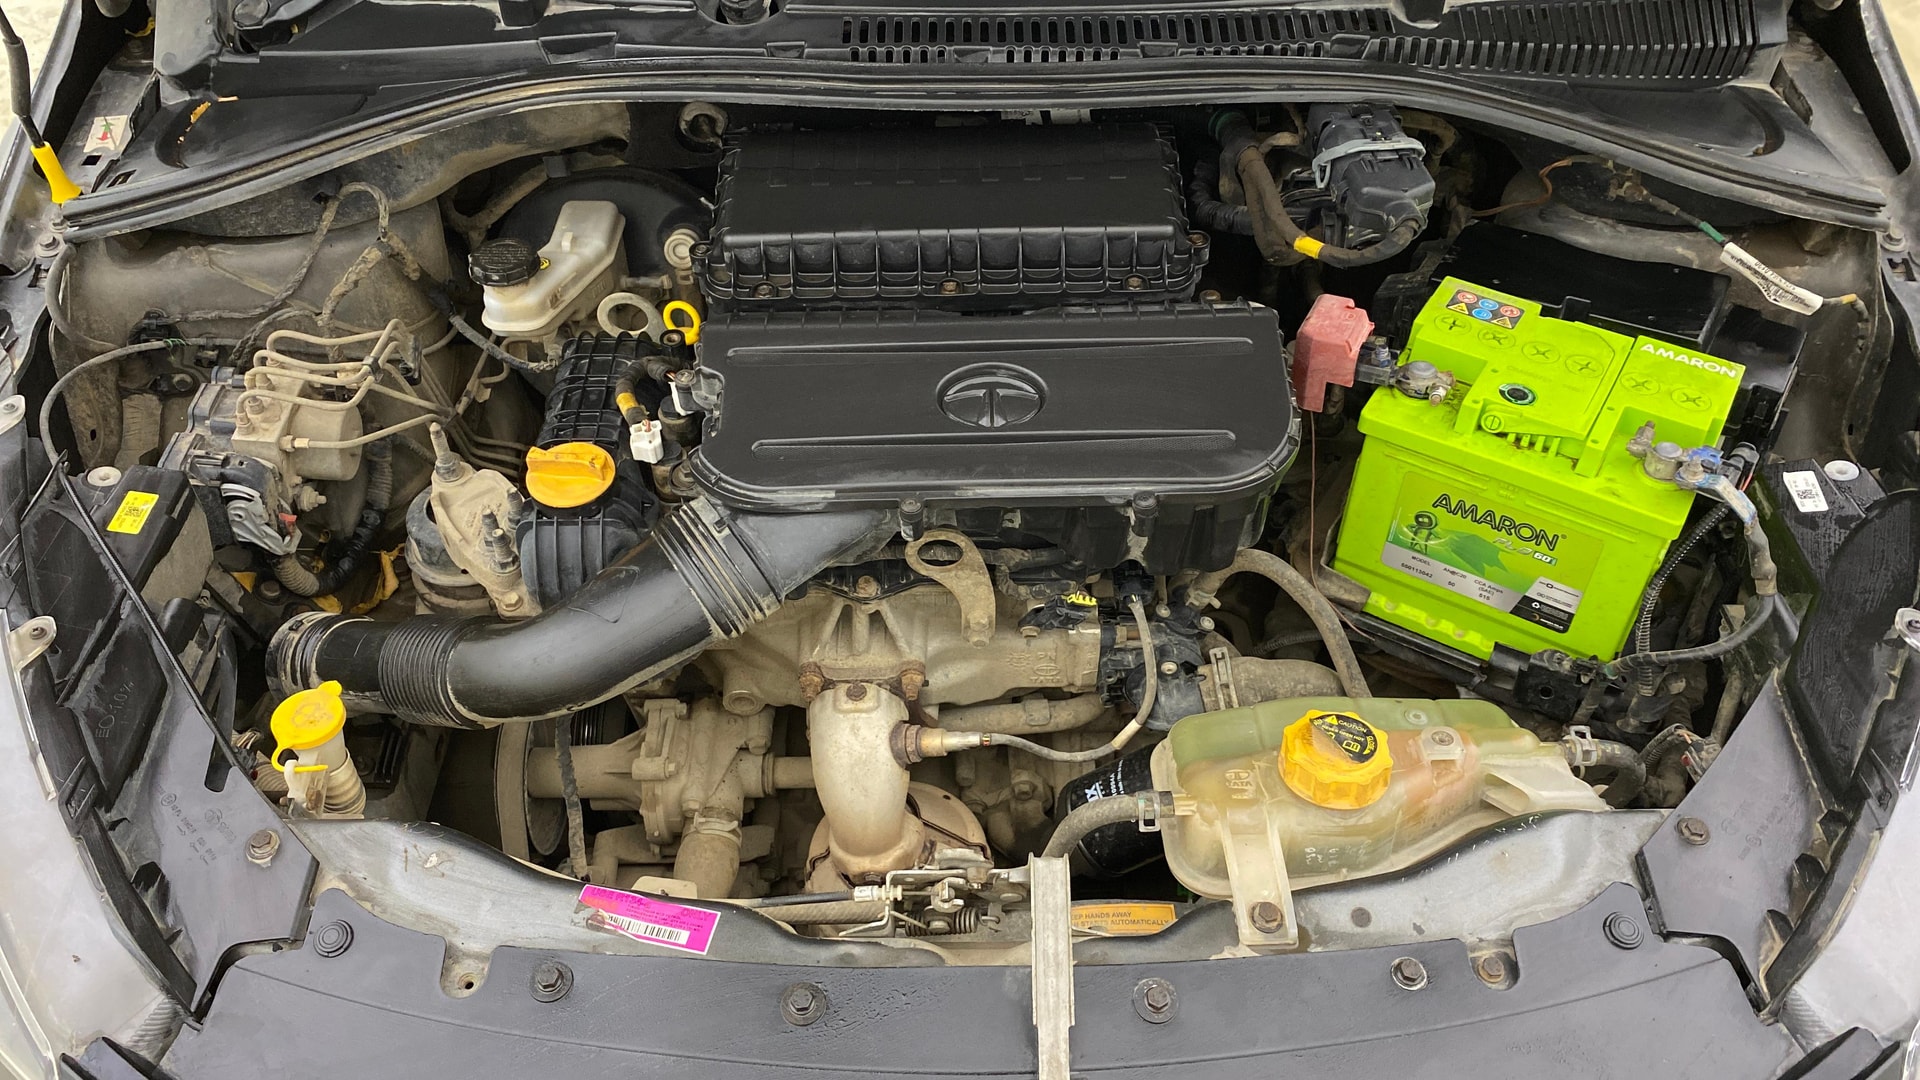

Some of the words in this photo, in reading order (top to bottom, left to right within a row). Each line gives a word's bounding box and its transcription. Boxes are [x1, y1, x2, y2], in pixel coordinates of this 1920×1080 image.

[1640, 343, 1736, 378] AMARON
[1432, 493, 1559, 551] AMARON
[1338, 719, 1367, 733] CAUTION
[1110, 918, 1169, 926] AUTOMATICALLY
